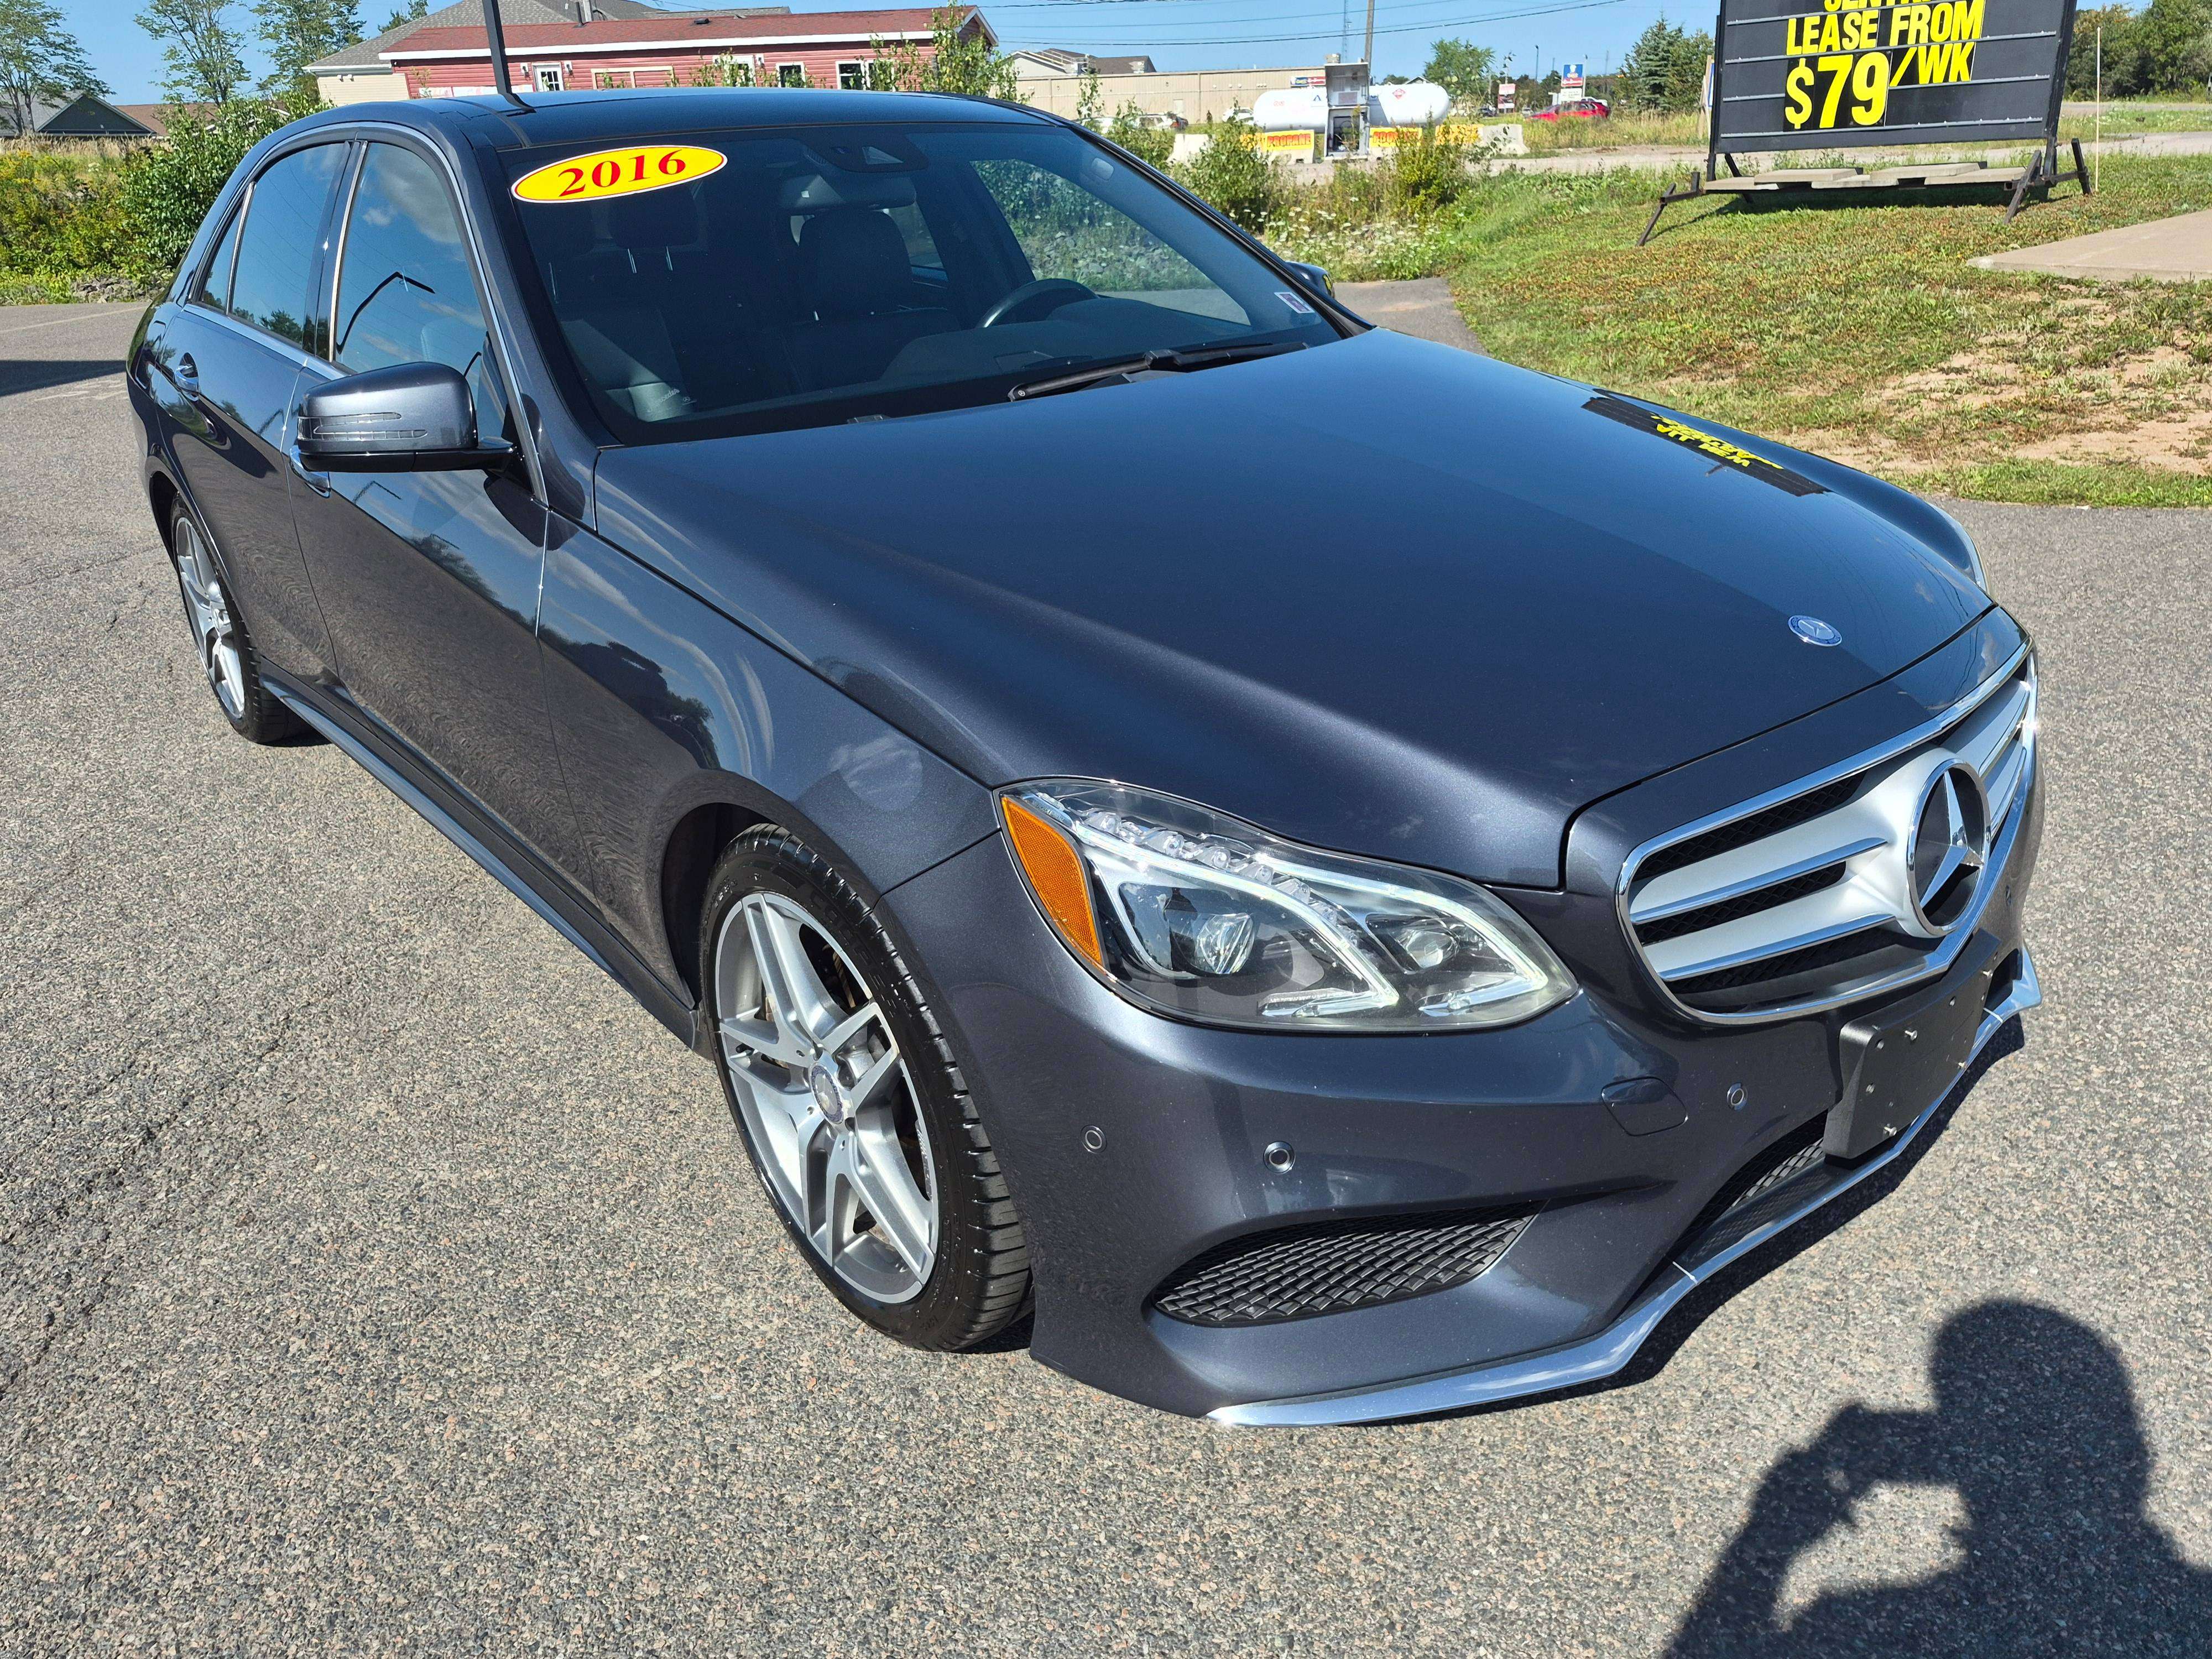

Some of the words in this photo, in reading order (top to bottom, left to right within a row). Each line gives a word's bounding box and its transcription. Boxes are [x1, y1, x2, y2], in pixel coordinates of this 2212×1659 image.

[1786, 10, 1880, 55] LEASE
[1890, 0, 1984, 46] FROM
[1267, 133, 1311, 147] PROPANE
[558, 149, 686, 197] 2016
